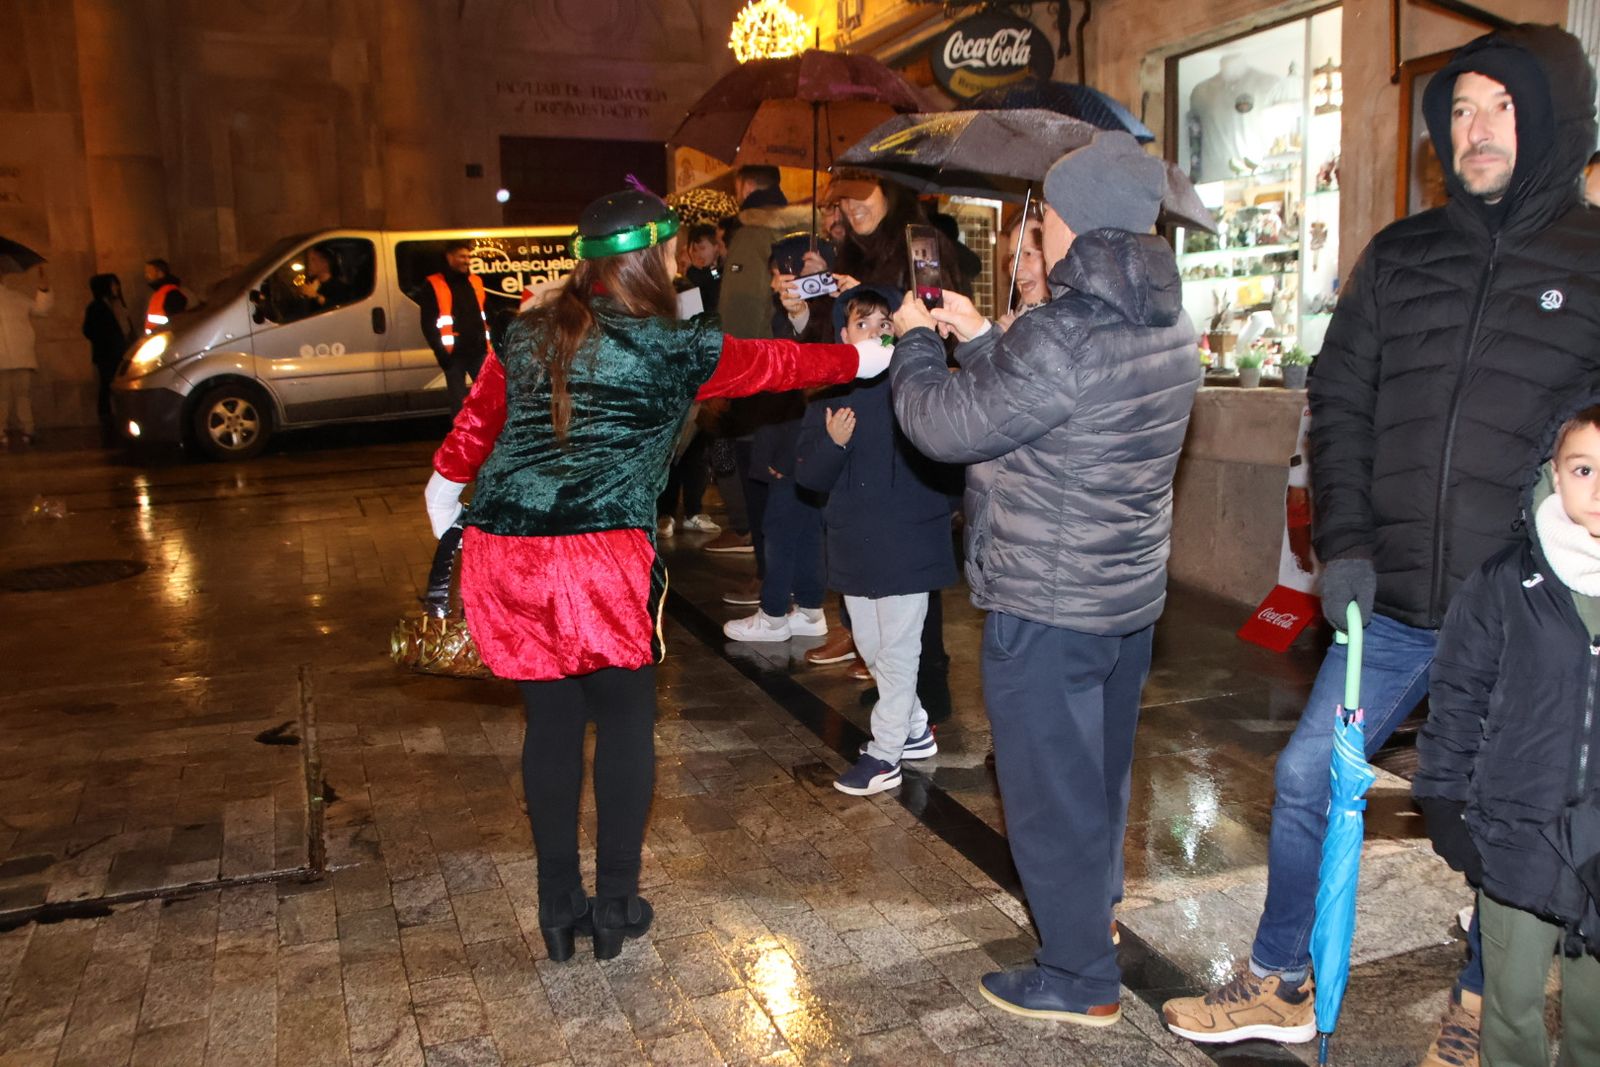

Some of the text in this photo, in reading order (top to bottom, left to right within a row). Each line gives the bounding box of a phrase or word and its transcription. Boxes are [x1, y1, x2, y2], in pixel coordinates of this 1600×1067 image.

[943, 28, 1032, 69] Coca-Cola
[517, 244, 566, 255] GRUP
[501, 271, 524, 293] el
